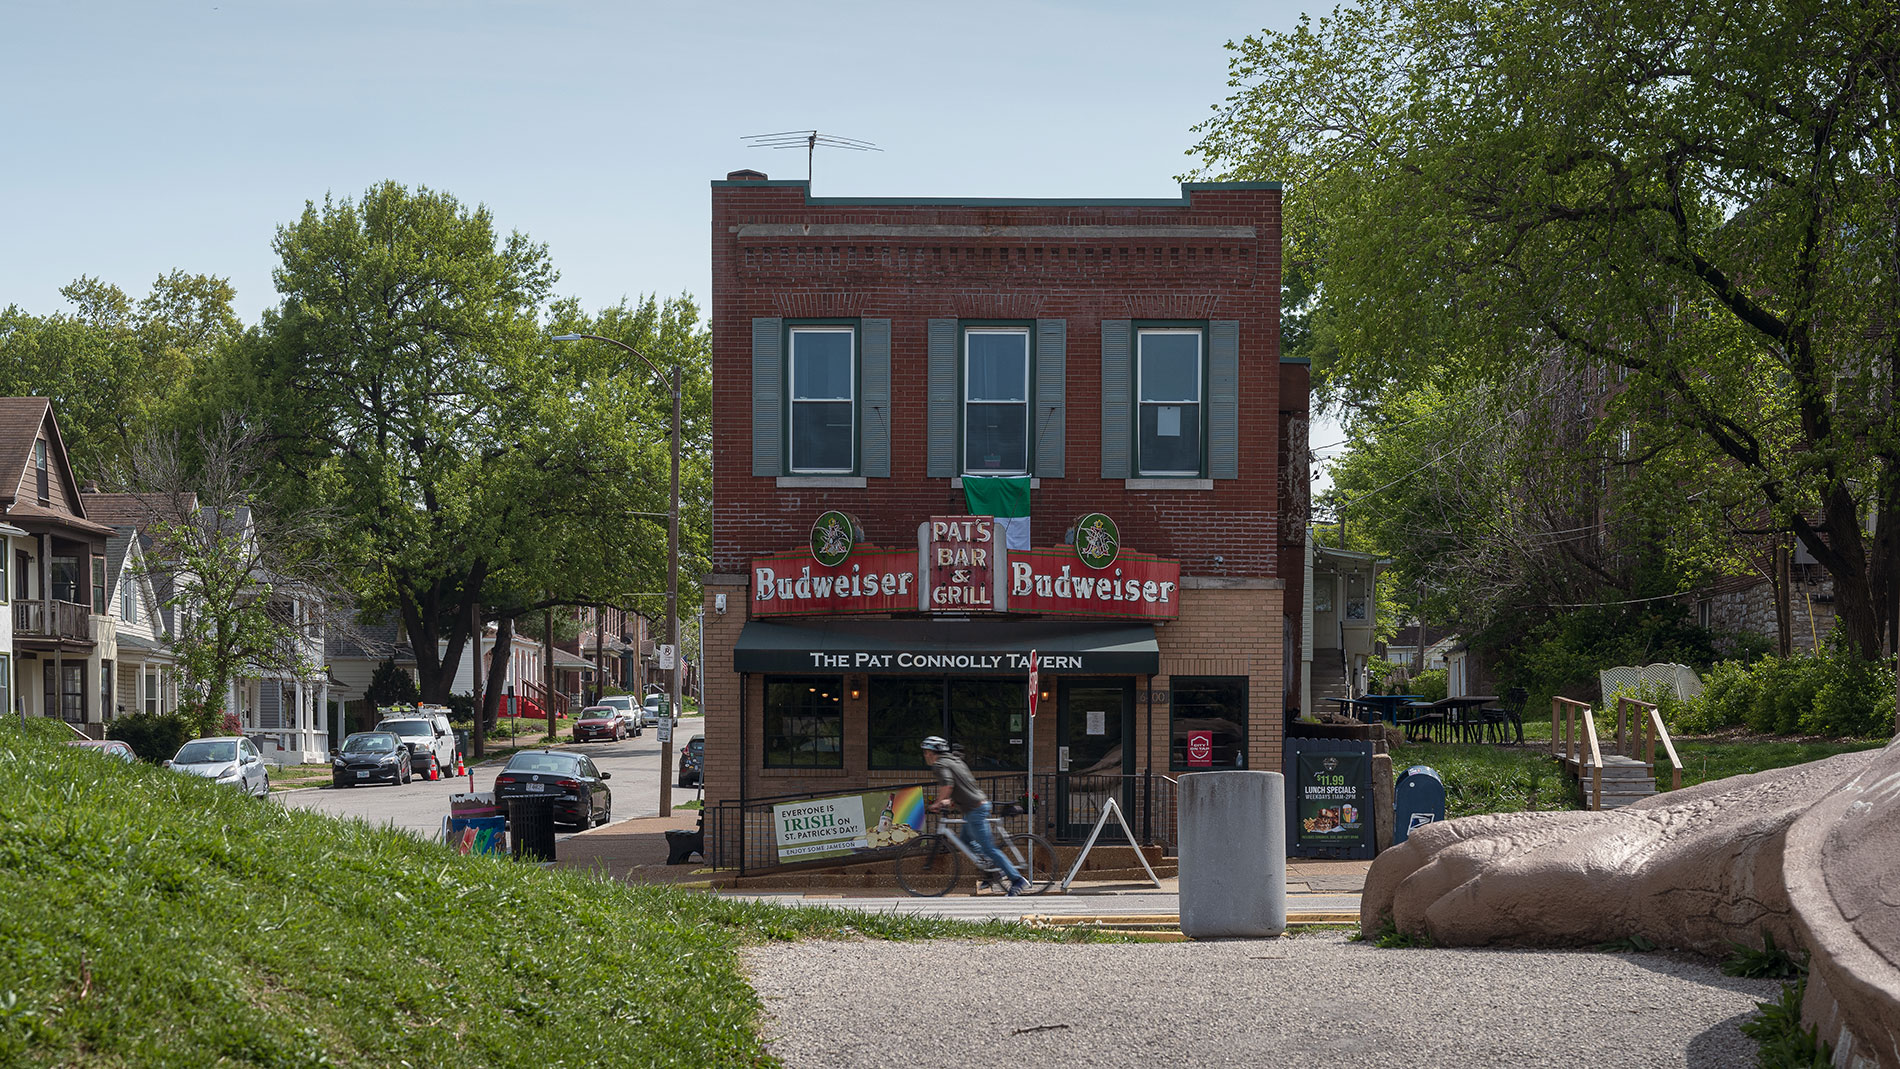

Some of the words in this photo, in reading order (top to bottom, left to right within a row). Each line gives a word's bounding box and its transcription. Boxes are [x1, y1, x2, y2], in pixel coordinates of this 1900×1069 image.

[933, 520, 991, 543] PAT'S
[938, 548, 986, 567] BAR
[755, 563, 914, 601] Budweiser
[952, 569, 971, 583] &
[1012, 561, 1176, 603] Budweiser
[933, 585, 991, 605] GRILL
[810, 652, 850, 667] THE
[855, 652, 893, 667] PAT
[897, 652, 1002, 668] CONNOLLY
[1140, 692, 1165, 702] 600
[1317, 775, 1344, 785] $11.99
[782, 806, 825, 818] EVERYONE
[826, 804, 834, 812] IS
[784, 814, 834, 832] IRISH
[838, 818, 850, 826] ON
[784, 833, 796, 841] ST.
[797, 827, 838, 839] PATRICK'S
[840, 825, 858, 834] DAY!
[808, 845, 824, 853] SOME
[826, 841, 855, 851] JAMESON
